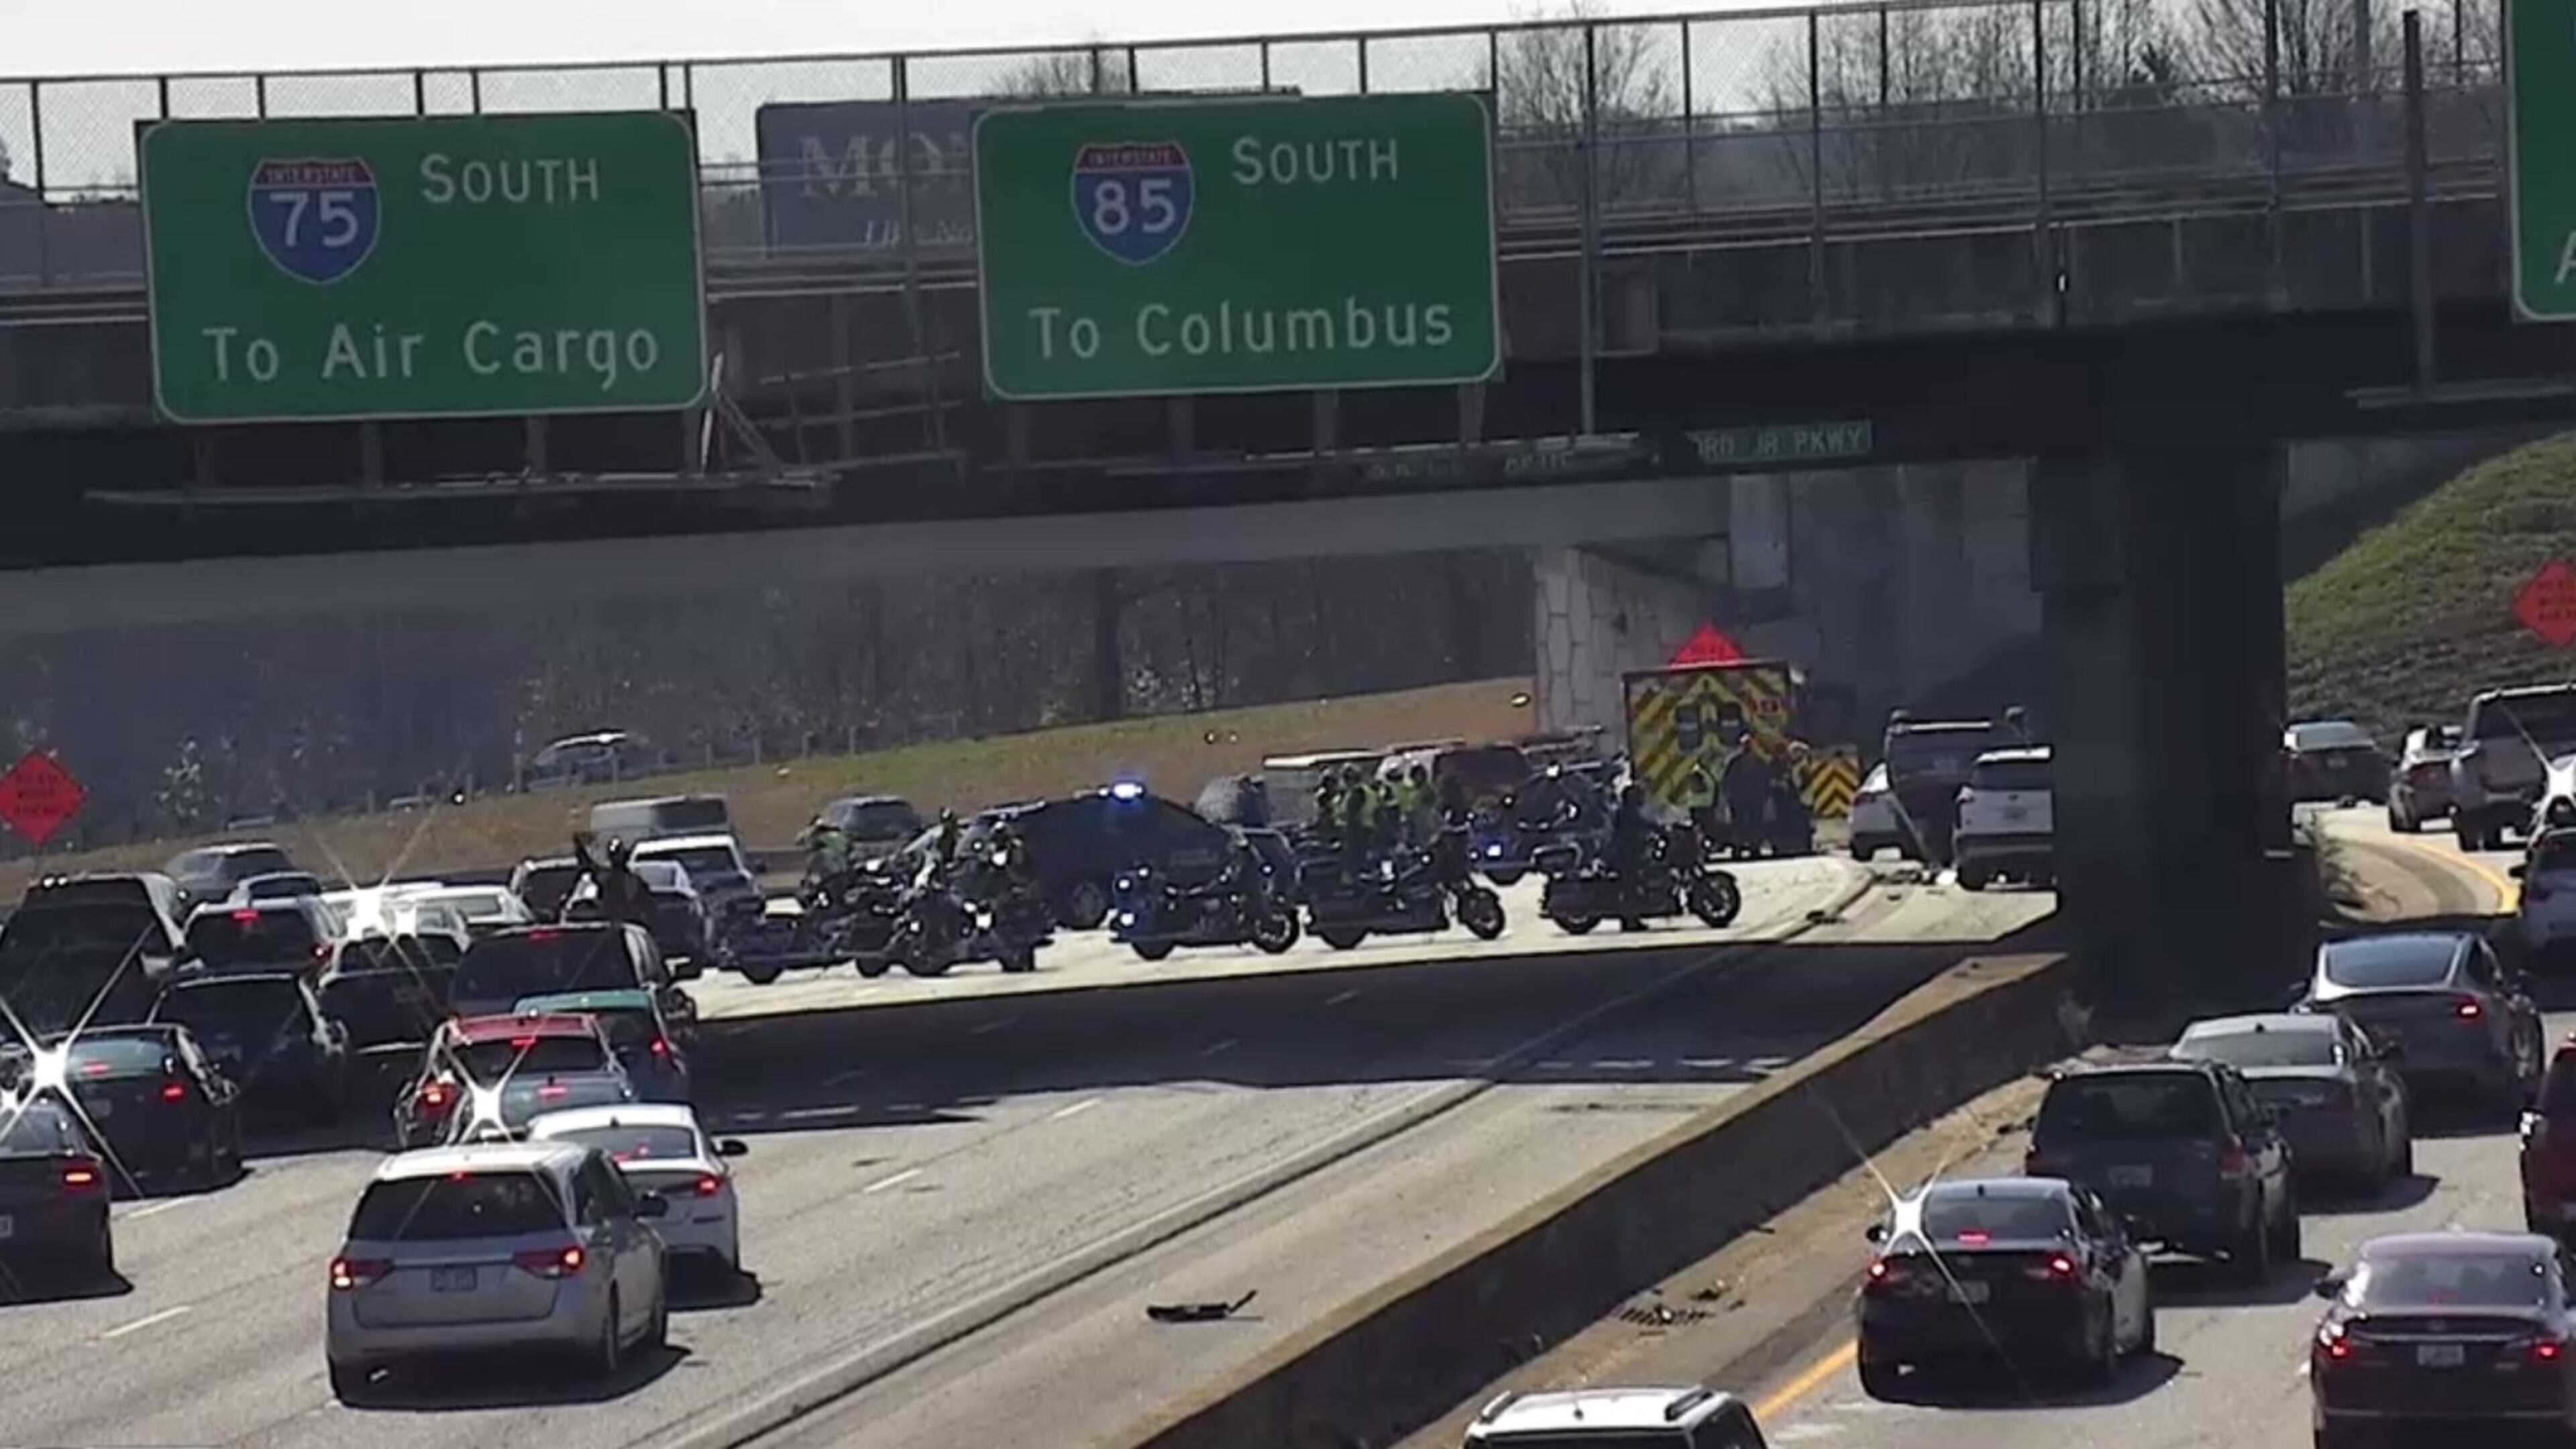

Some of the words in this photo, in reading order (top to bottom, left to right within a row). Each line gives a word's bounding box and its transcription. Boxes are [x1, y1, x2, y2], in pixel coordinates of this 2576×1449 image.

[266, 165, 356, 182] INTERSTATE
[420, 153, 600, 204] SOUTH
[1087, 149, 1176, 166] INTERSTATE
[1232, 135, 1399, 185] SOUTH
[269, 191, 360, 248] 75
[1093, 178, 1175, 235] 85
[202, 327, 279, 383] To
[321, 323, 423, 379] Air
[464, 319, 659, 390] Cargo
[1028, 307, 1100, 360] To
[1136, 299, 1454, 358] Columbus
[1794, 425, 1864, 454] PKWY
